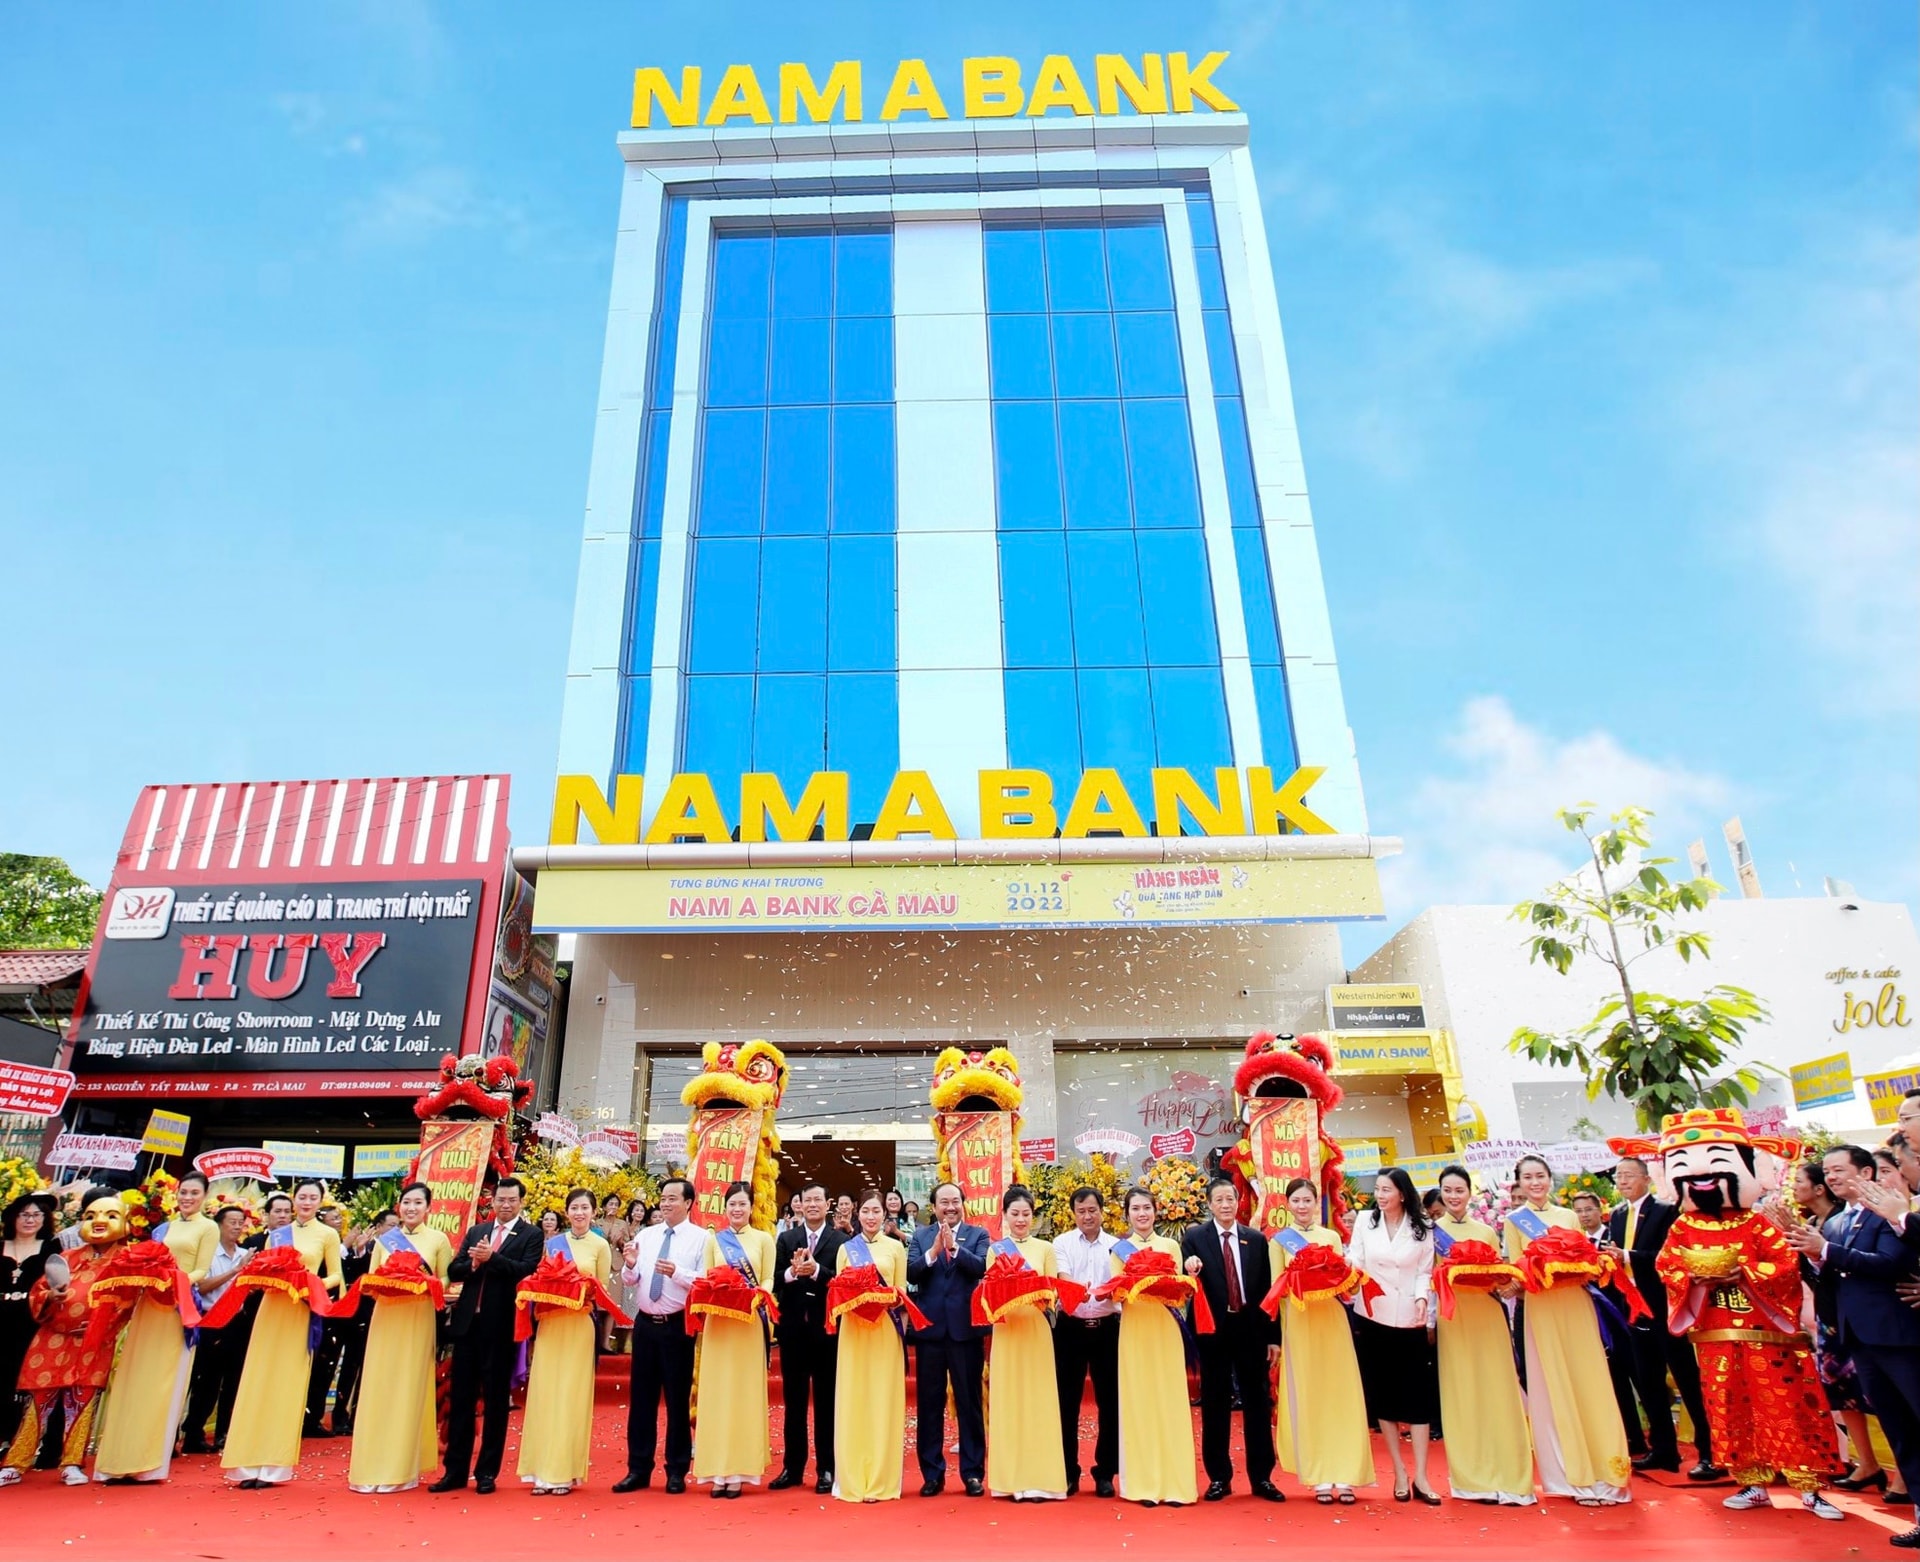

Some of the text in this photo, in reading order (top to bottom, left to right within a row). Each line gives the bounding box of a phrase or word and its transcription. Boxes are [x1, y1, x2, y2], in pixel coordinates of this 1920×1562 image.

[631, 51, 1240, 128] NAM A BANK
[549, 766, 1335, 846] NAM A BANK
[670, 879, 704, 889] TƯNG
[742, 879, 771, 888] KHAI
[774, 877, 824, 888] TRƯƠNG
[1008, 882, 1060, 893] 01.12
[1134, 869, 1177, 889] HÀNG
[173, 889, 471, 923] THIẾT KẾ QUẢNG CÁO VÀ TRANG TRÍ NỘI THẤT
[669, 889, 957, 917] NAM A BANK CÀ MAU
[1008, 896, 1063, 910] 2022
[168, 932, 386, 1000] HUY
[1825, 965, 1902, 984] coffee & cake
[1833, 982, 1912, 1034] joli
[95, 1010, 133, 1029] Thiết
[136, 1010, 163, 1029] Kế
[163, 1012, 188, 1029] Thi
[193, 1011, 231, 1032] Công
[236, 1011, 312, 1028] Showroom
[329, 1011, 361, 1031] Mặt
[365, 1011, 406, 1031] Dựng
[413, 1010, 441, 1027] Alu
[86, 1037, 126, 1058] Bảng
[128, 1038, 165, 1057] Hiệu
[168, 1037, 198, 1053] Đèn
[201, 1037, 233, 1053] Led
[244, 1036, 278, 1054] Màn
[282, 1035, 321, 1053] Hình
[325, 1036, 356, 1052] Led
[361, 1035, 390, 1052] Các
[1340, 1047, 1429, 1059] NAM A BANK
[104, 1081, 146, 1091] NGUYỄN
[150, 1080, 170, 1090] TẤT
[175, 1081, 210, 1091] THÀNH
[282, 1082, 306, 1090] MAU
[1866, 1080, 1887, 1099] C.TY
[1138, 1093, 1196, 1129] Happy
[56, 1135, 85, 1151] QUANG
[112, 1139, 142, 1154] IPHONE
[709, 1124, 743, 1151] TẤN
[1467, 1141, 1491, 1150] NAM
[1507, 1140, 1538, 1150] BANK
[440, 1151, 471, 1169] KHAI
[962, 1139, 997, 1160] VẠN
[1271, 1149, 1301, 1168] ĐÁO
[706, 1158, 734, 1182] TÀI
[968, 1166, 991, 1188] SỰ
